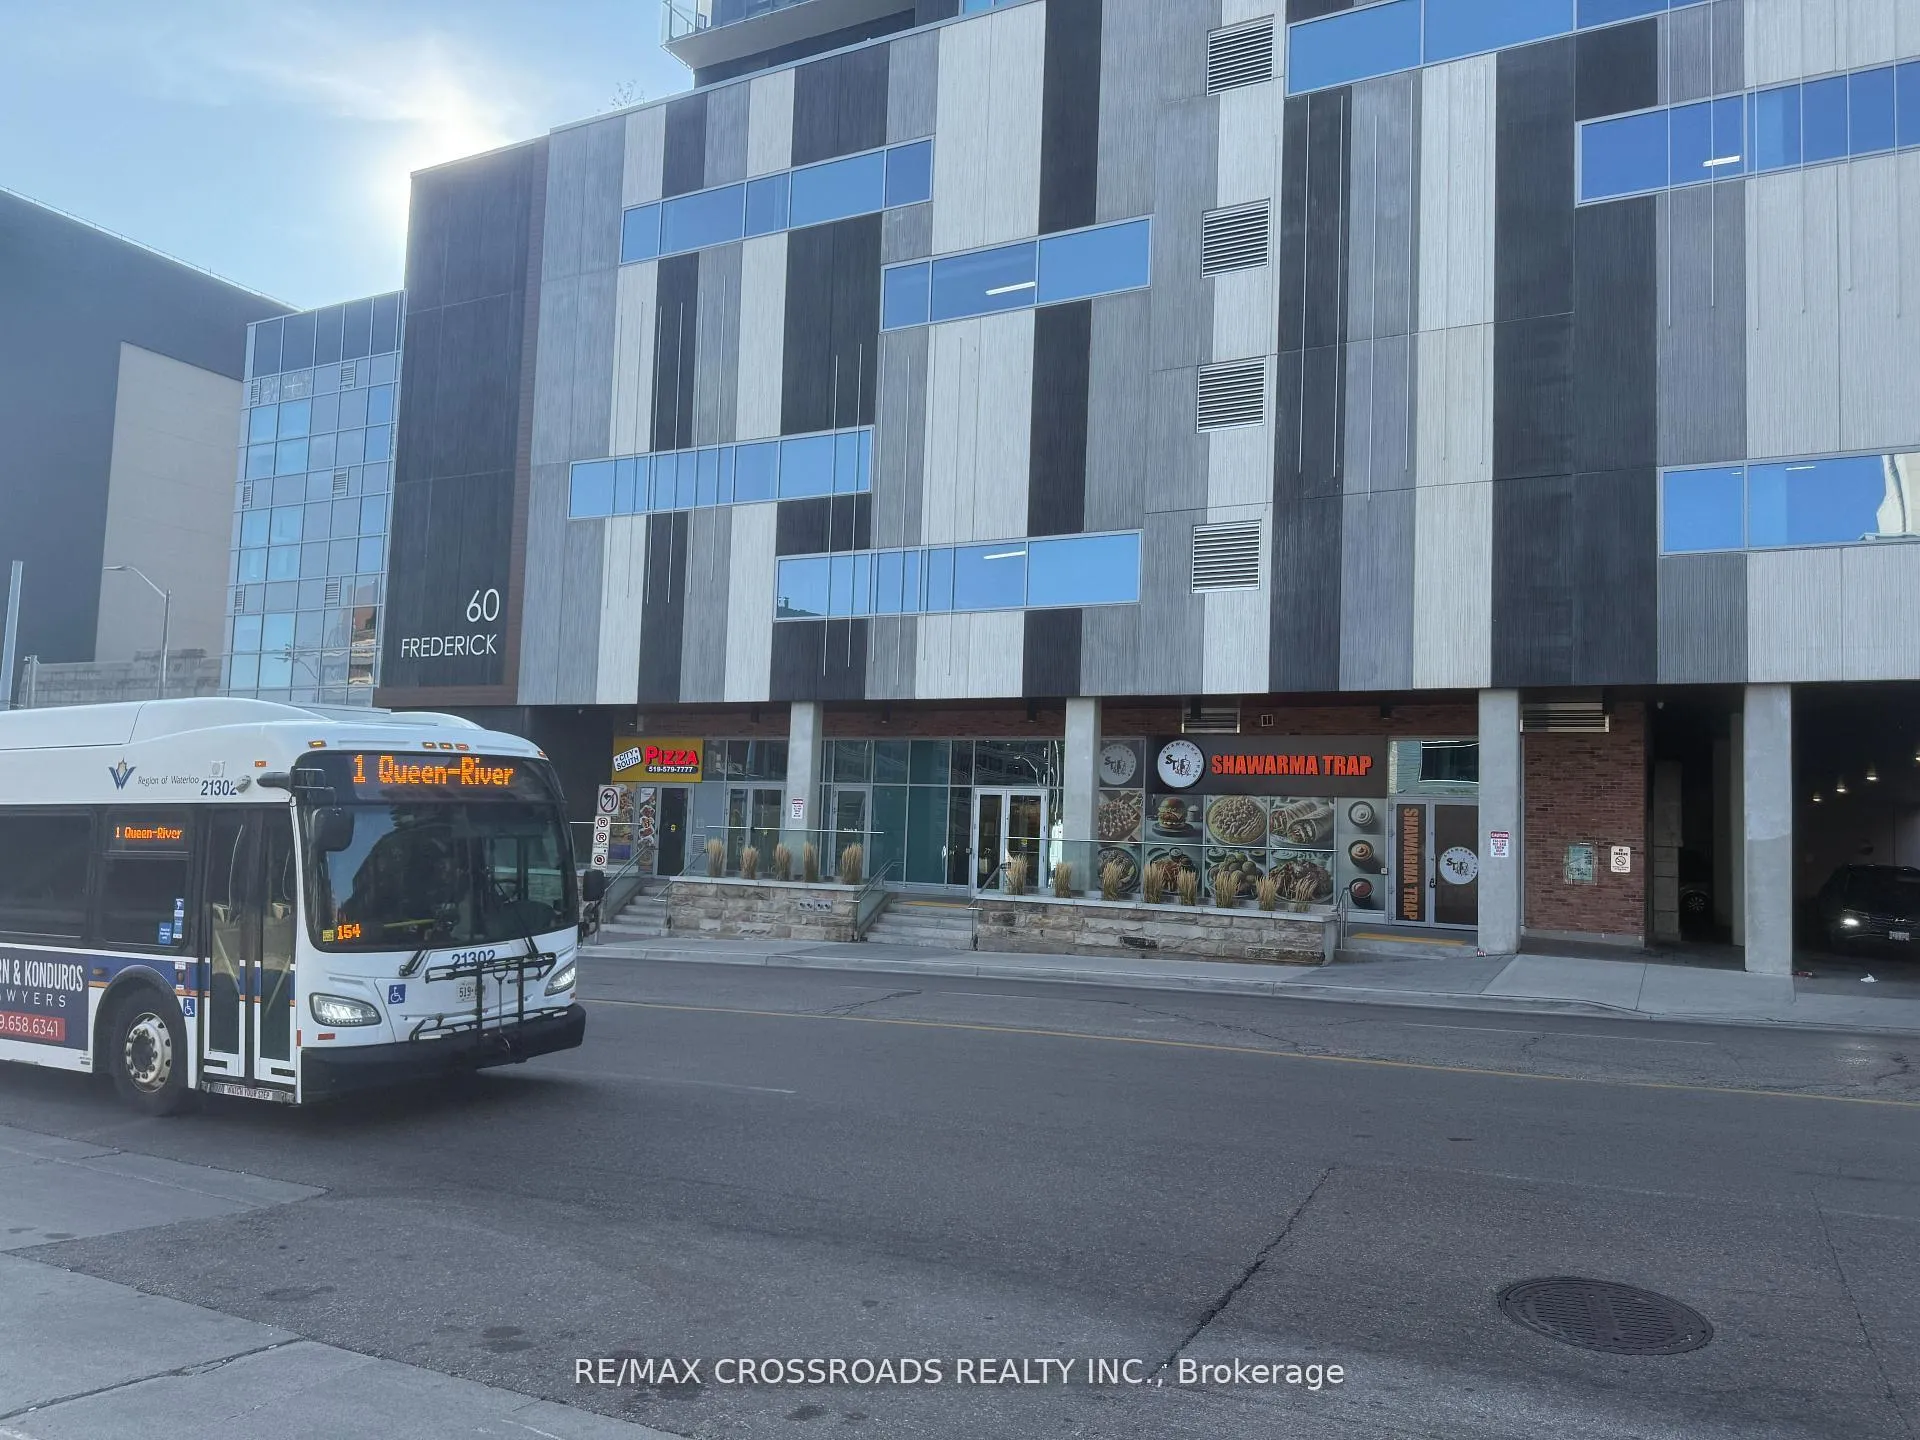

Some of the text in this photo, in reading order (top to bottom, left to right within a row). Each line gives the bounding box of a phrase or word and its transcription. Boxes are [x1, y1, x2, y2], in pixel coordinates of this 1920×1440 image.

[466, 588, 500, 622] 60
[401, 634, 497, 658] FREDERICK
[616, 756, 639, 770] SOUTH
[619, 749, 635, 762] CITY
[645, 746, 698, 766] PIZZA
[353, 754, 513, 785] 1 Queen-River
[1211, 755, 1373, 776] SHAWARMA TRAP
[138, 775, 200, 787] Region of Waterloo
[200, 780, 237, 796] 21302
[115, 826, 183, 839] 1 Queen-River
[1403, 808, 1419, 920] SHAWARMA TRAP
[337, 924, 360, 939] 154
[452, 950, 495, 968] 21302
[0, 958, 83, 991] N & KONDUROS
[0, 988, 66, 1007] WYERS
